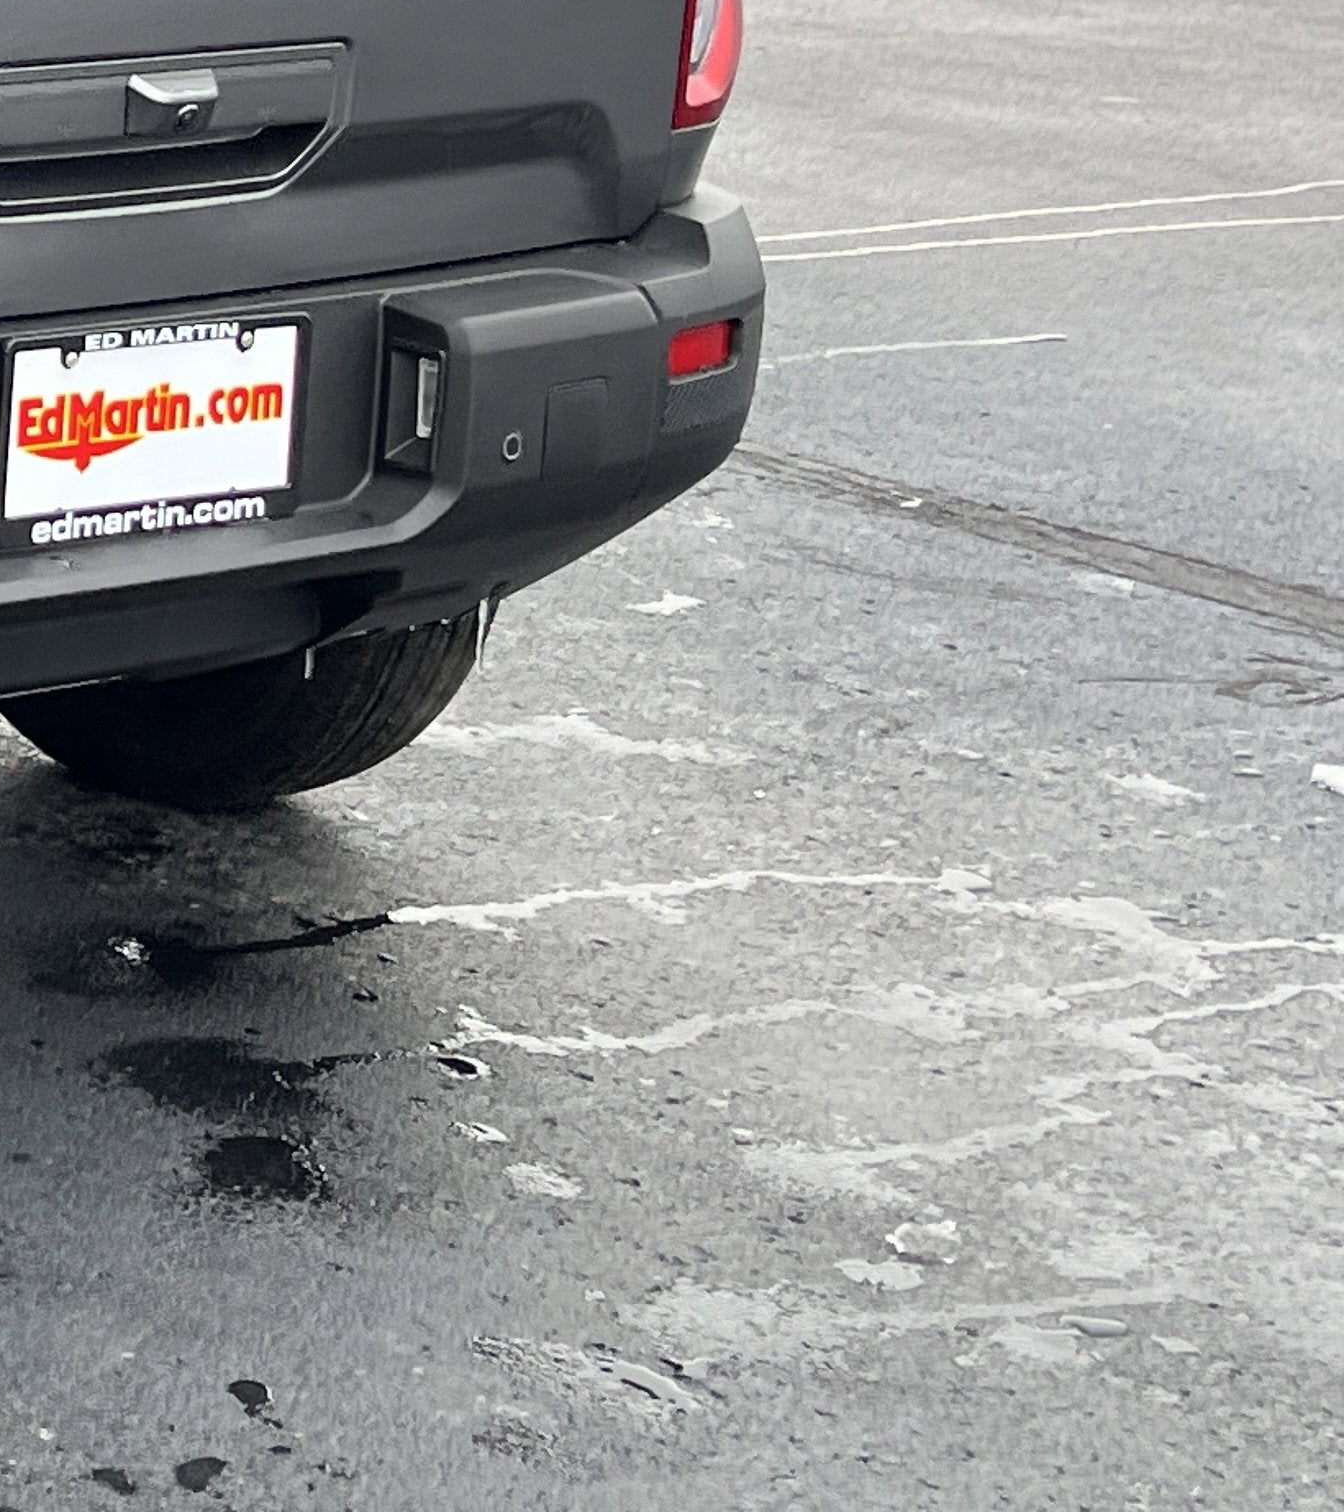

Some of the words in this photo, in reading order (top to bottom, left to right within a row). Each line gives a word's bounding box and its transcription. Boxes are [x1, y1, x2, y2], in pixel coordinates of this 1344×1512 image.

[84, 332, 124, 352] ED
[130, 322, 240, 348] MARTIN
[30, 495, 266, 545] edmartin.com
